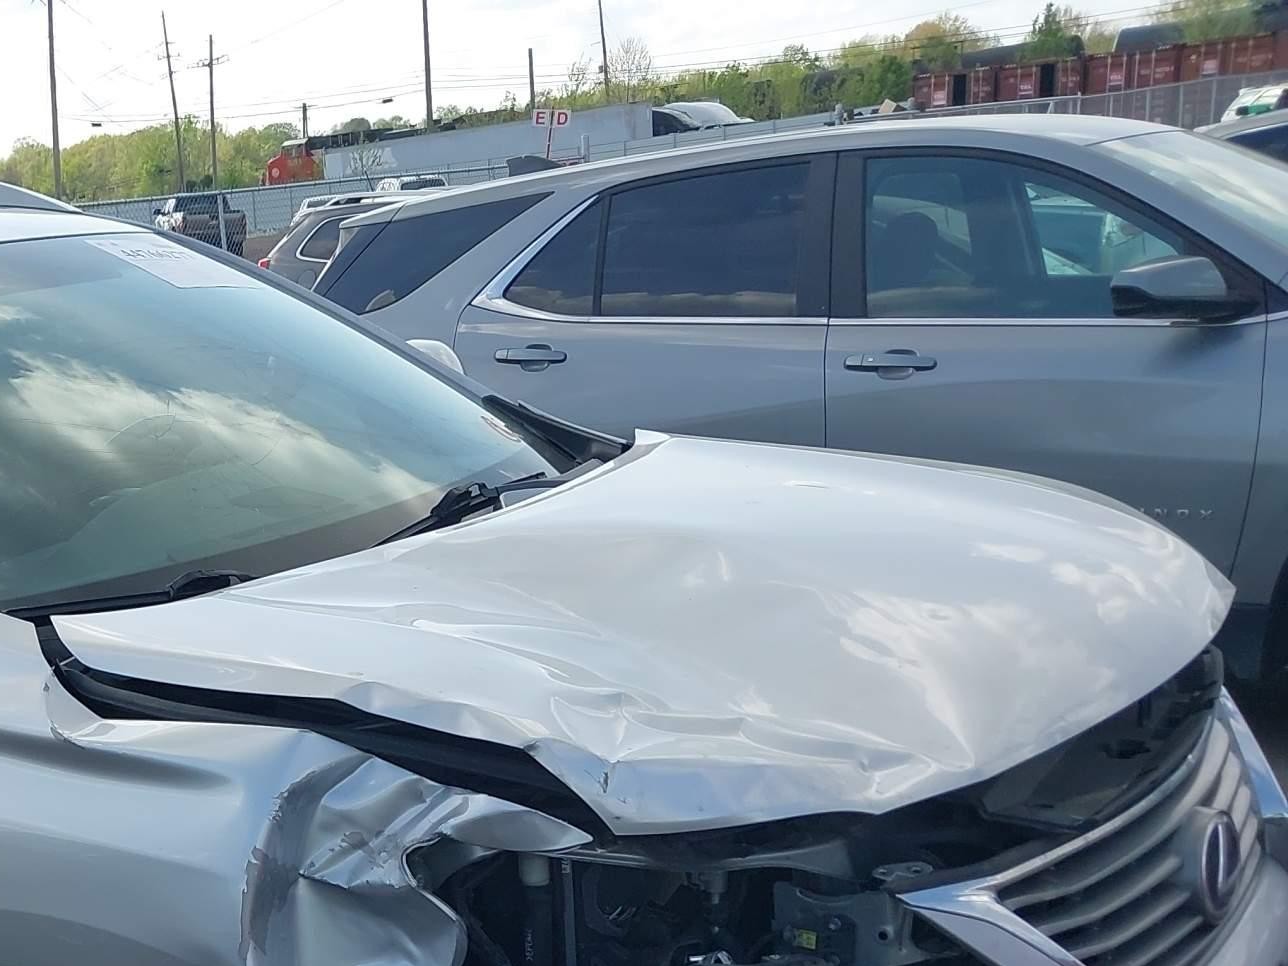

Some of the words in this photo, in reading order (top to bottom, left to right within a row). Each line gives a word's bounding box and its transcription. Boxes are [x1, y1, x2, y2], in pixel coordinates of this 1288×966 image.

[535, 111, 546, 125] E
[557, 111, 568, 125] D
[1140, 508, 1212, 520] NOX
